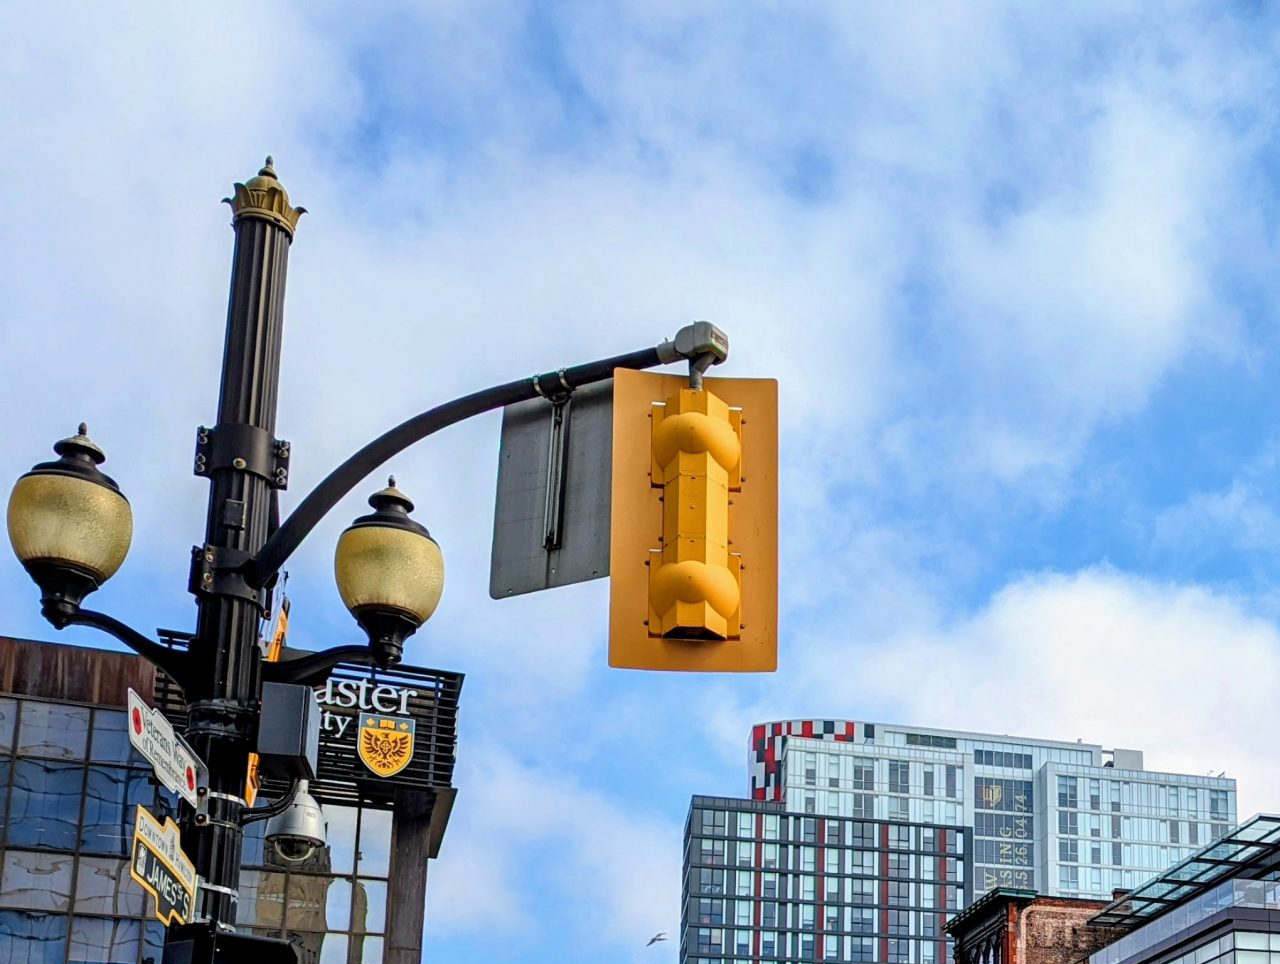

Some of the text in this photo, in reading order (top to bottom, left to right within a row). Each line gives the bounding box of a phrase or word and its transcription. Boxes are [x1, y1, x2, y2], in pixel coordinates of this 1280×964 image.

[141, 706, 187, 777] Veterans Way
[149, 743, 187, 790] Remembrance
[139, 816, 169, 857] DOWNTOWN
[146, 857, 176, 906] JAMES
[181, 893, 190, 920] S
